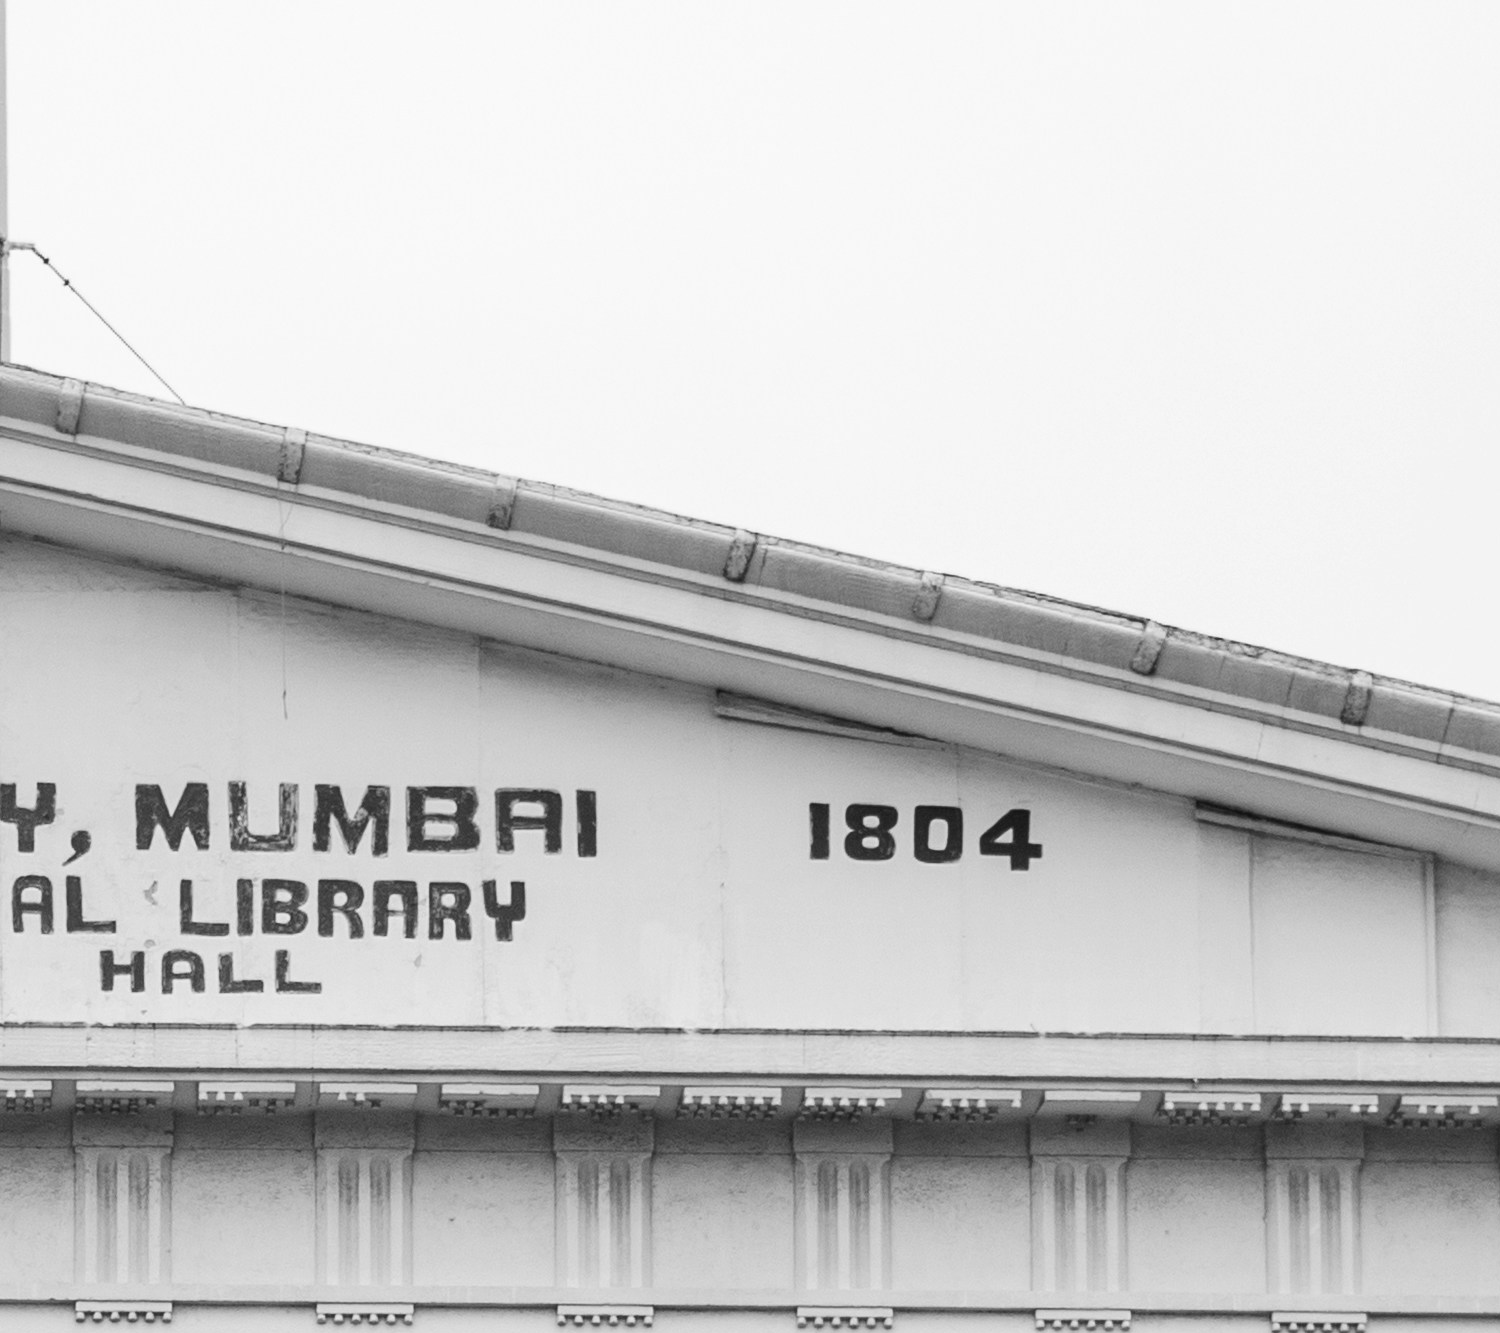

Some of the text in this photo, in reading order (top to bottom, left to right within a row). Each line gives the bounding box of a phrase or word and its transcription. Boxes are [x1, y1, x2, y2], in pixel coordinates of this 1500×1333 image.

[134, 782, 597, 858] MUMBAI
[808, 802, 1043, 872] 1804
[179, 878, 526, 942] LIBRARY
[99, 949, 322, 995] HALL
